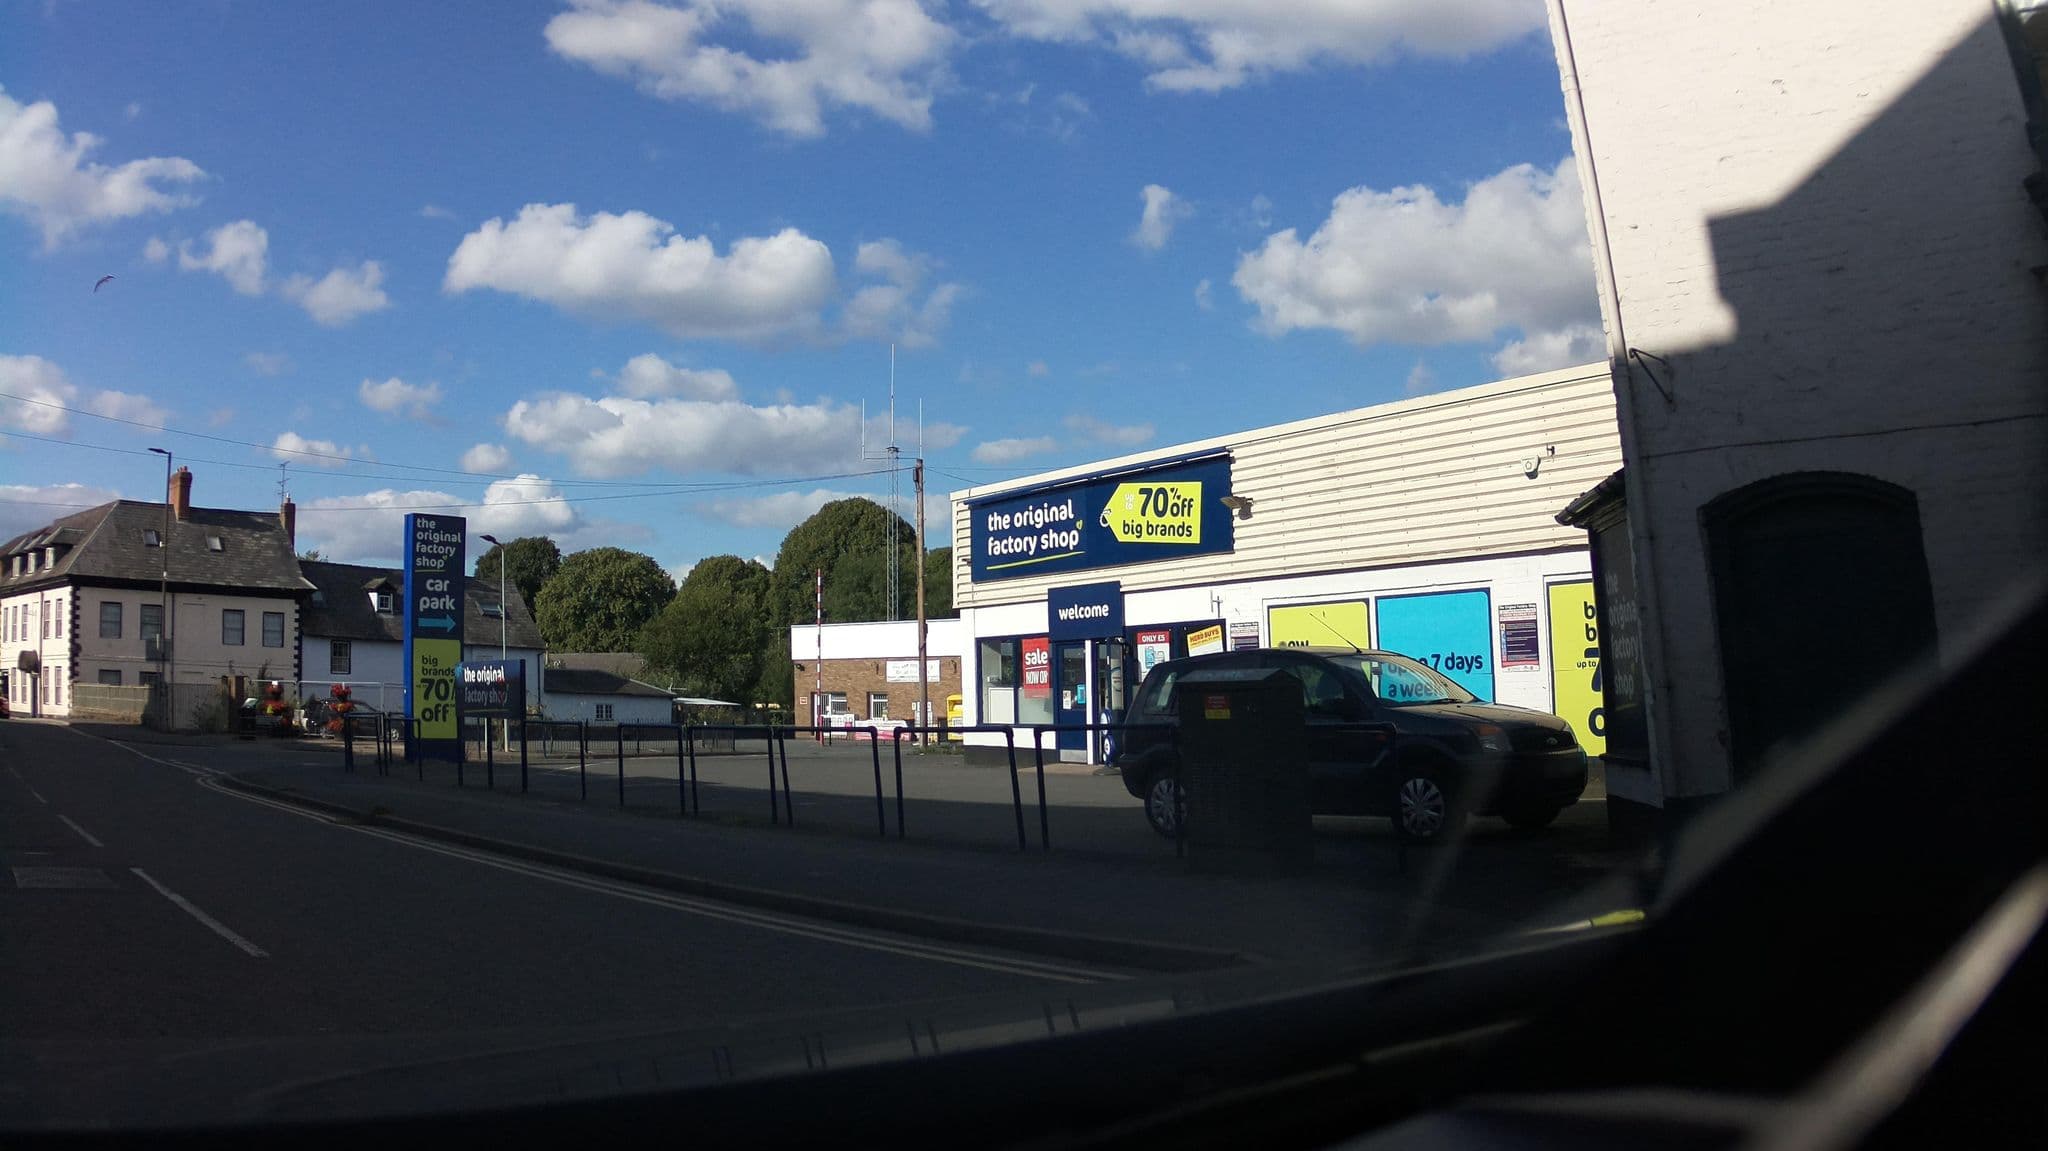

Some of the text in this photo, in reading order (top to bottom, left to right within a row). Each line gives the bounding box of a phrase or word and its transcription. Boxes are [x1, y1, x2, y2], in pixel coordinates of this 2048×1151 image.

[1139, 487, 1194, 518] 70% off
[988, 499, 1074, 531] the original
[416, 518, 436, 529] the
[1123, 520, 1193, 538] big brands
[416, 530, 462, 543] original
[987, 529, 1079, 556] factory shop
[416, 542, 456, 557] factory
[415, 556, 445, 569] shop
[426, 578, 450, 592] car
[420, 595, 455, 612] park
[1058, 603, 1109, 621] welcome
[1142, 634, 1157, 642] ONLY
[422, 655, 438, 667] big
[1025, 648, 1048, 666] sale
[1444, 652, 1483, 673] days
[1577, 661, 1587, 669] up
[422, 665, 455, 677] brands
[464, 664, 505, 685] the original
[1025, 671, 1039, 685] NOW
[464, 687, 488, 706] factory
[1388, 684, 1397, 697] a
[421, 703, 449, 723] off
